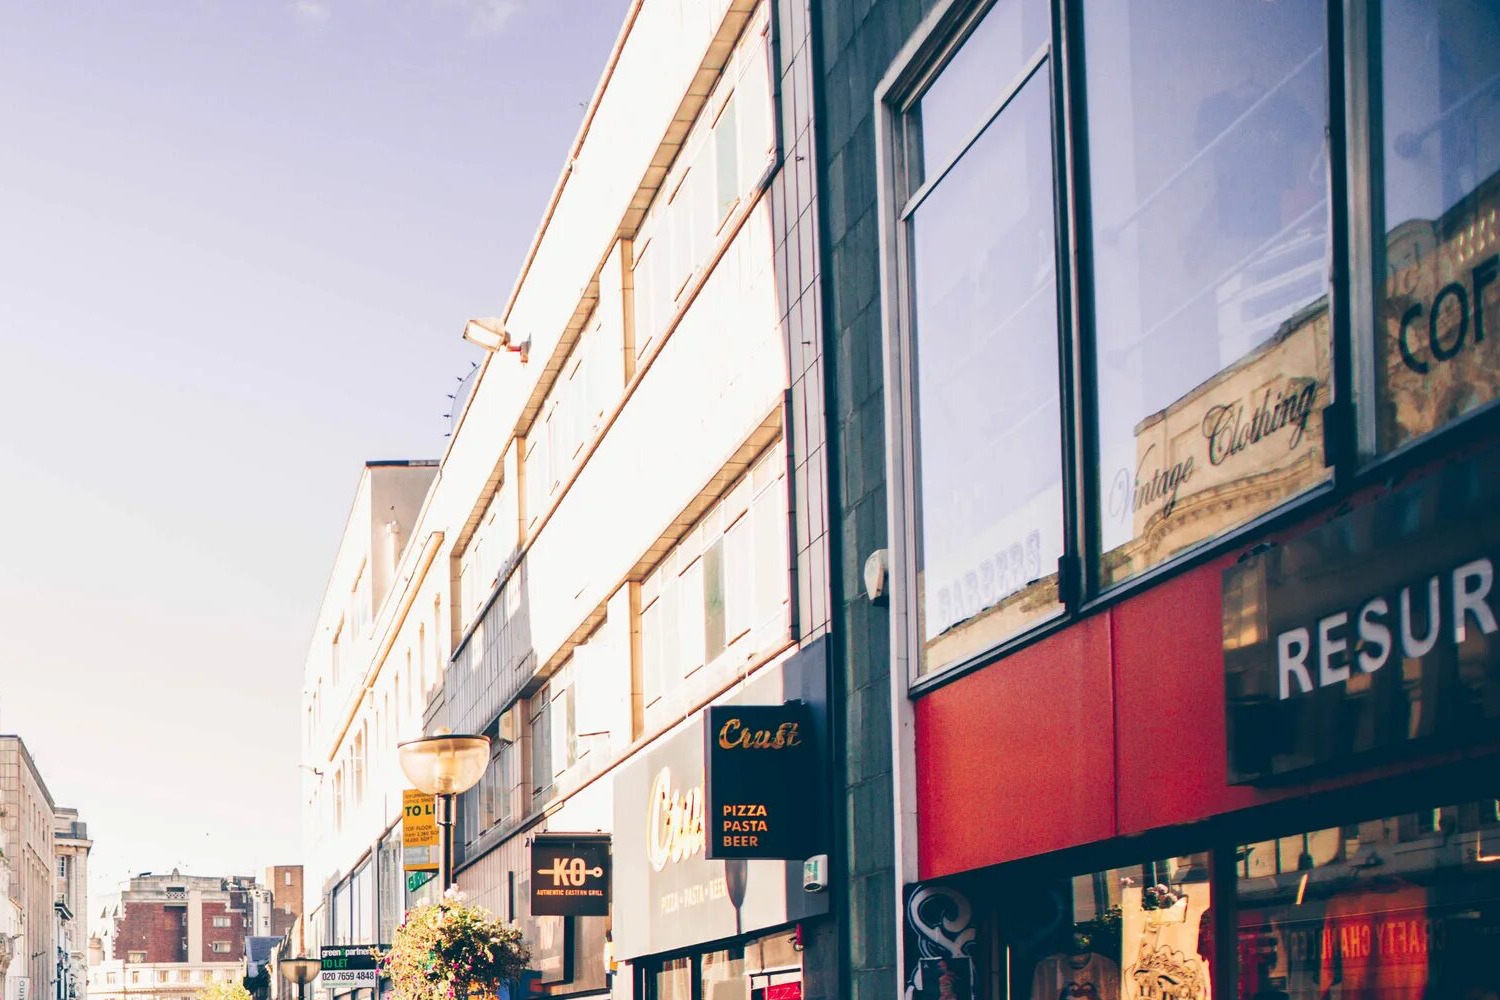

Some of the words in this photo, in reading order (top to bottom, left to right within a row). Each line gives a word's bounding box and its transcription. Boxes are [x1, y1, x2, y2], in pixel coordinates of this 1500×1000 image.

[1109, 443, 1194, 524] Vintage
[1202, 379, 1316, 466] Clothing
[1277, 557, 1499, 700] RESUR
[718, 718, 802, 750] Crust
[405, 805, 422, 817] TO
[723, 805, 767, 817] PIZZA
[723, 820, 768, 832] PASTA
[723, 836, 759, 847] BEER
[553, 858, 586, 886] KO
[684, 883, 705, 908] PASTA
[322, 948, 372, 958] green&partner
[323, 959, 333, 968] TO
[334, 959, 348, 968] LET
[322, 972, 336, 981] 020
[337, 972, 355, 981] 7659
[356, 971, 375, 980] 4848
